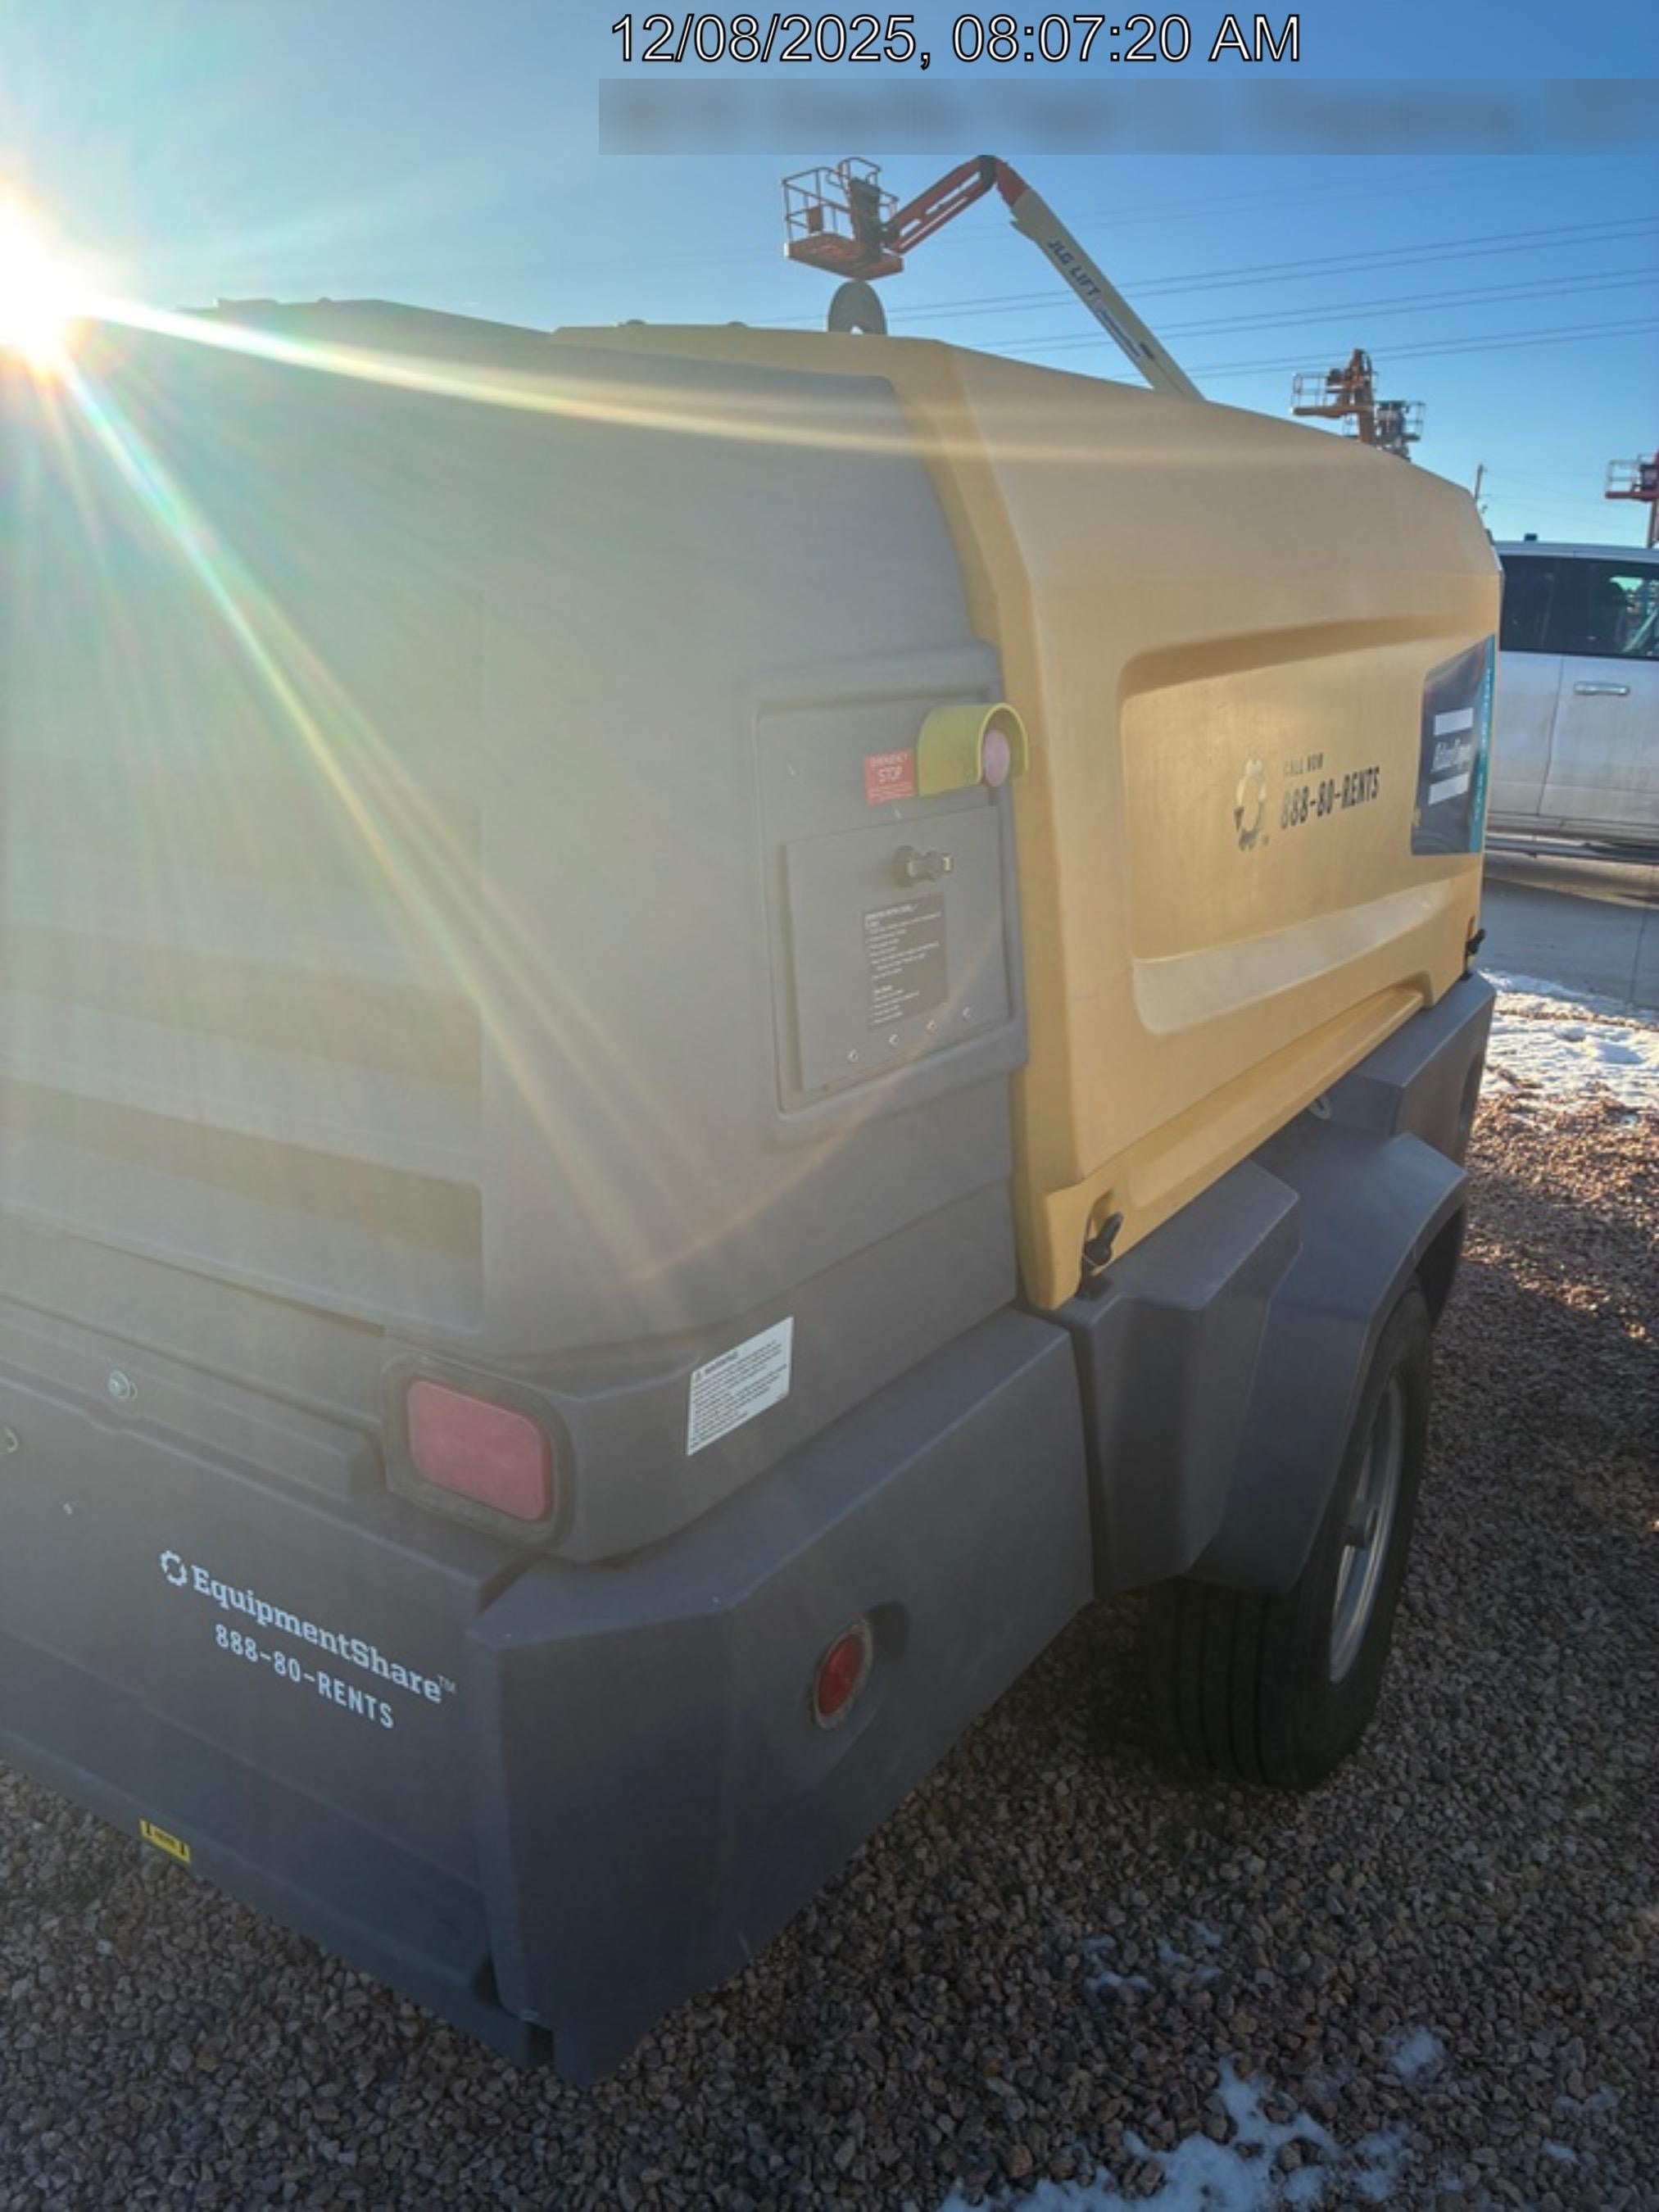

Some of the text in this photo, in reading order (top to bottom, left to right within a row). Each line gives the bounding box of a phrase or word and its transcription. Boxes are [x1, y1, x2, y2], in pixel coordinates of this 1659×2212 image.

[1049, 240, 1101, 296] JLG LIFT
[1281, 766, 1380, 830] 888-80-RENTS
[215, 1623, 394, 1729] 888-80-RENTS
